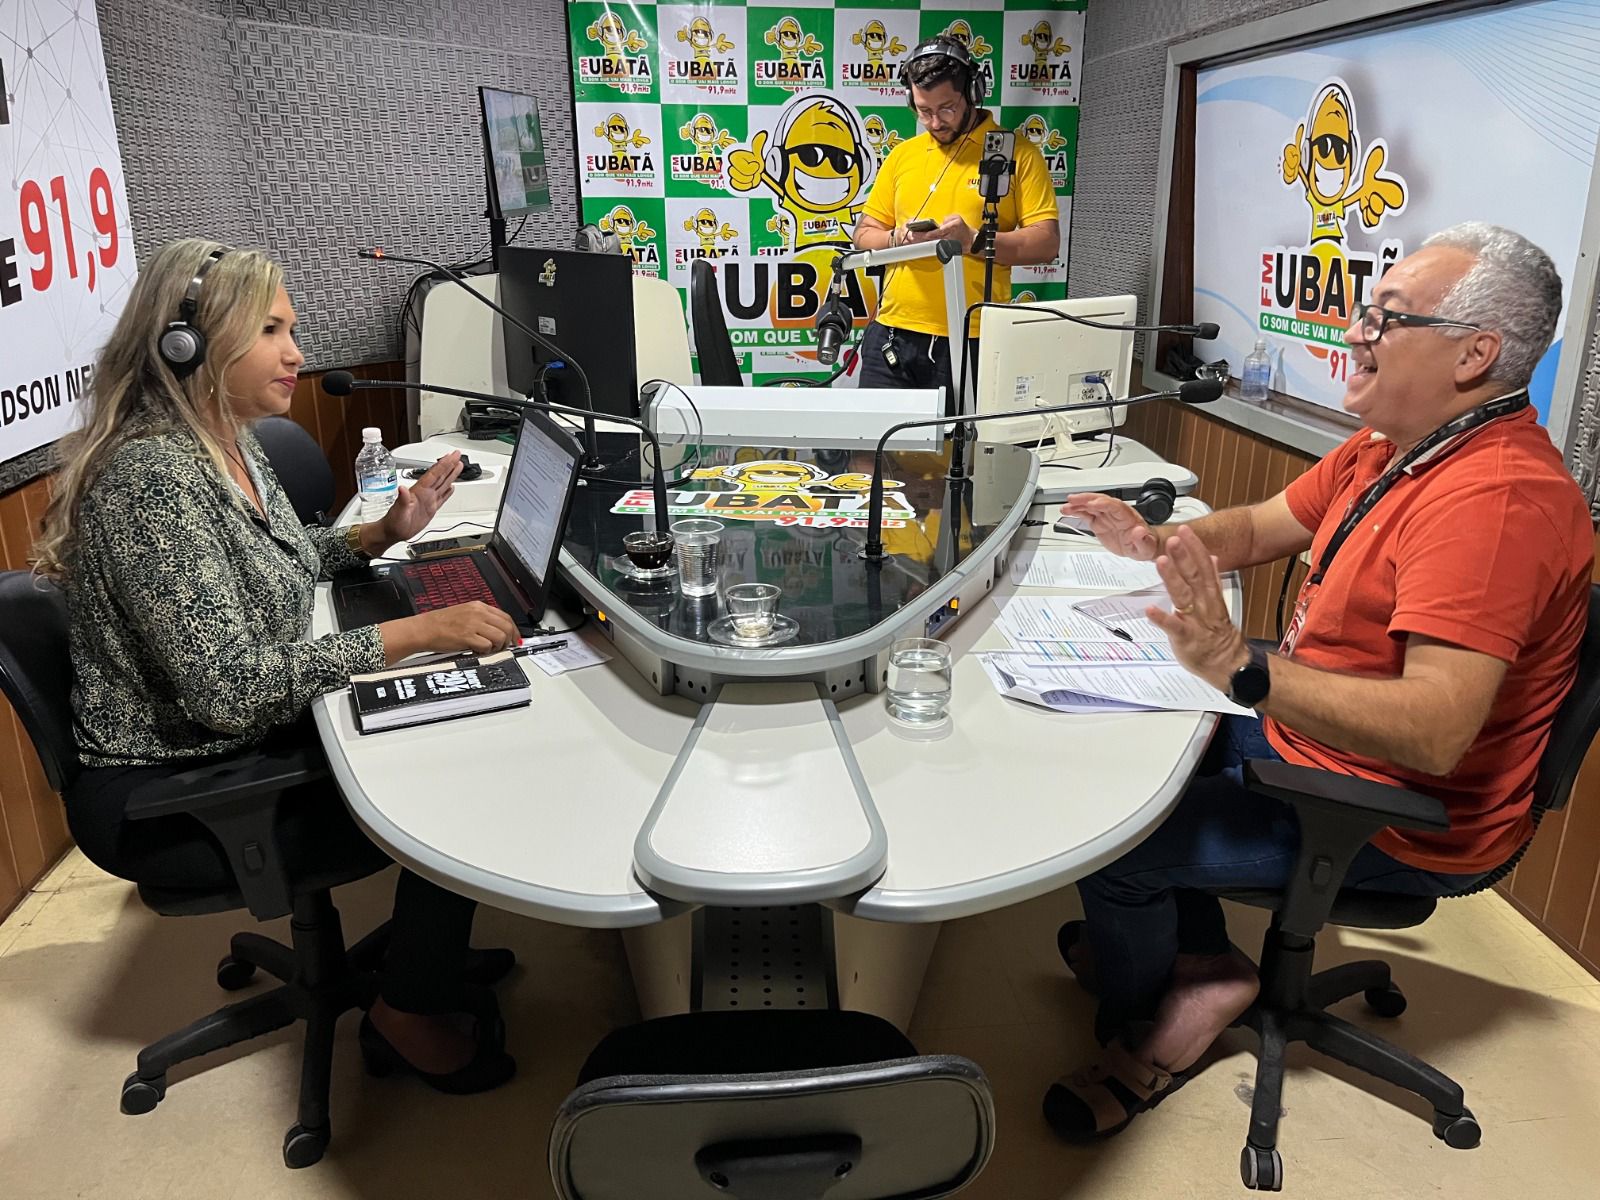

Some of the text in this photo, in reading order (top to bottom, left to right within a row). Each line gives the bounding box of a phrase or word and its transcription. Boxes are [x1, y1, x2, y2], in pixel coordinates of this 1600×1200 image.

[581, 59, 588, 75] FM
[589, 56, 650, 76] UBATÃ
[669, 61, 675, 77] FM
[677, 58, 737, 77] UBATÃ
[757, 62, 763, 78] FM
[764, 59, 824, 79] UBATÃ
[843, 64, 849, 79] FM
[1011, 64, 1017, 80] FM
[1018, 60, 1071, 80] UBATÃ
[587, 156, 594, 171] FM
[595, 152, 654, 171] UBATÃ
[673, 157, 679, 172] FM
[0, 167, 118, 308] E 91,9
[622, 244, 658, 263] ATÃ
[676, 249, 682, 264] FM
[1260, 254, 1274, 307] FM
[730, 331, 758, 344] OM
[764, 330, 801, 344] QUE
[1262, 315, 1345, 343] O SOM QUE VAI MA
[1330, 350, 1347, 382] 91
[0, 374, 61, 428] DSON
[666, 492, 907, 511] UBATÃ
